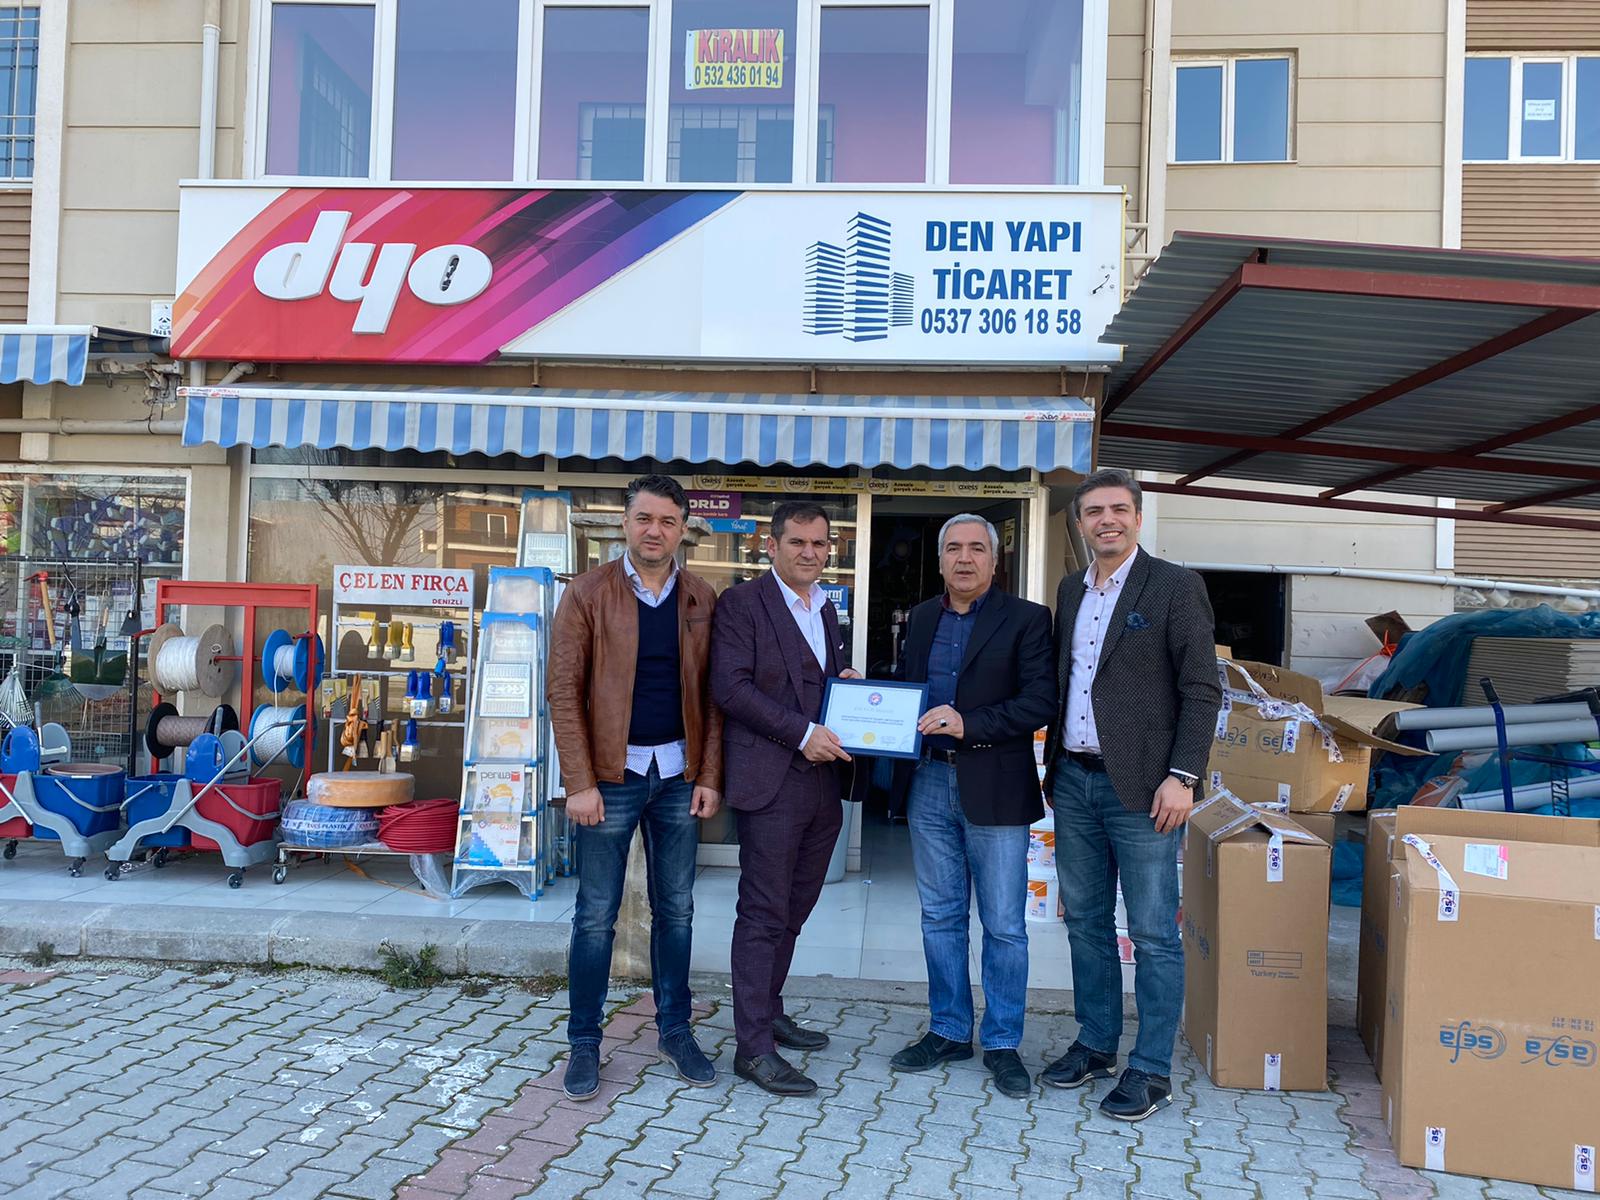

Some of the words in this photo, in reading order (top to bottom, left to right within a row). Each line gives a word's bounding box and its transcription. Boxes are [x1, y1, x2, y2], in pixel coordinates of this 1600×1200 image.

[695, 66, 701, 85] 0
[704, 66, 723, 85] 532
[727, 65, 746, 85] 436
[750, 66, 761, 85] 01
[766, 65, 778, 85] 94
[926, 221, 993, 252] DEN
[1005, 221, 1081, 252] YAPI
[253, 210, 493, 335] dyo
[933, 262, 1072, 300] TİCARET
[921, 308, 972, 334] 0537
[978, 308, 1016, 334] 306
[1024, 308, 1049, 334] 18
[1056, 308, 1081, 334] 58
[340, 572, 405, 592] ÇELEN
[411, 575, 469, 596] FIRÇA
